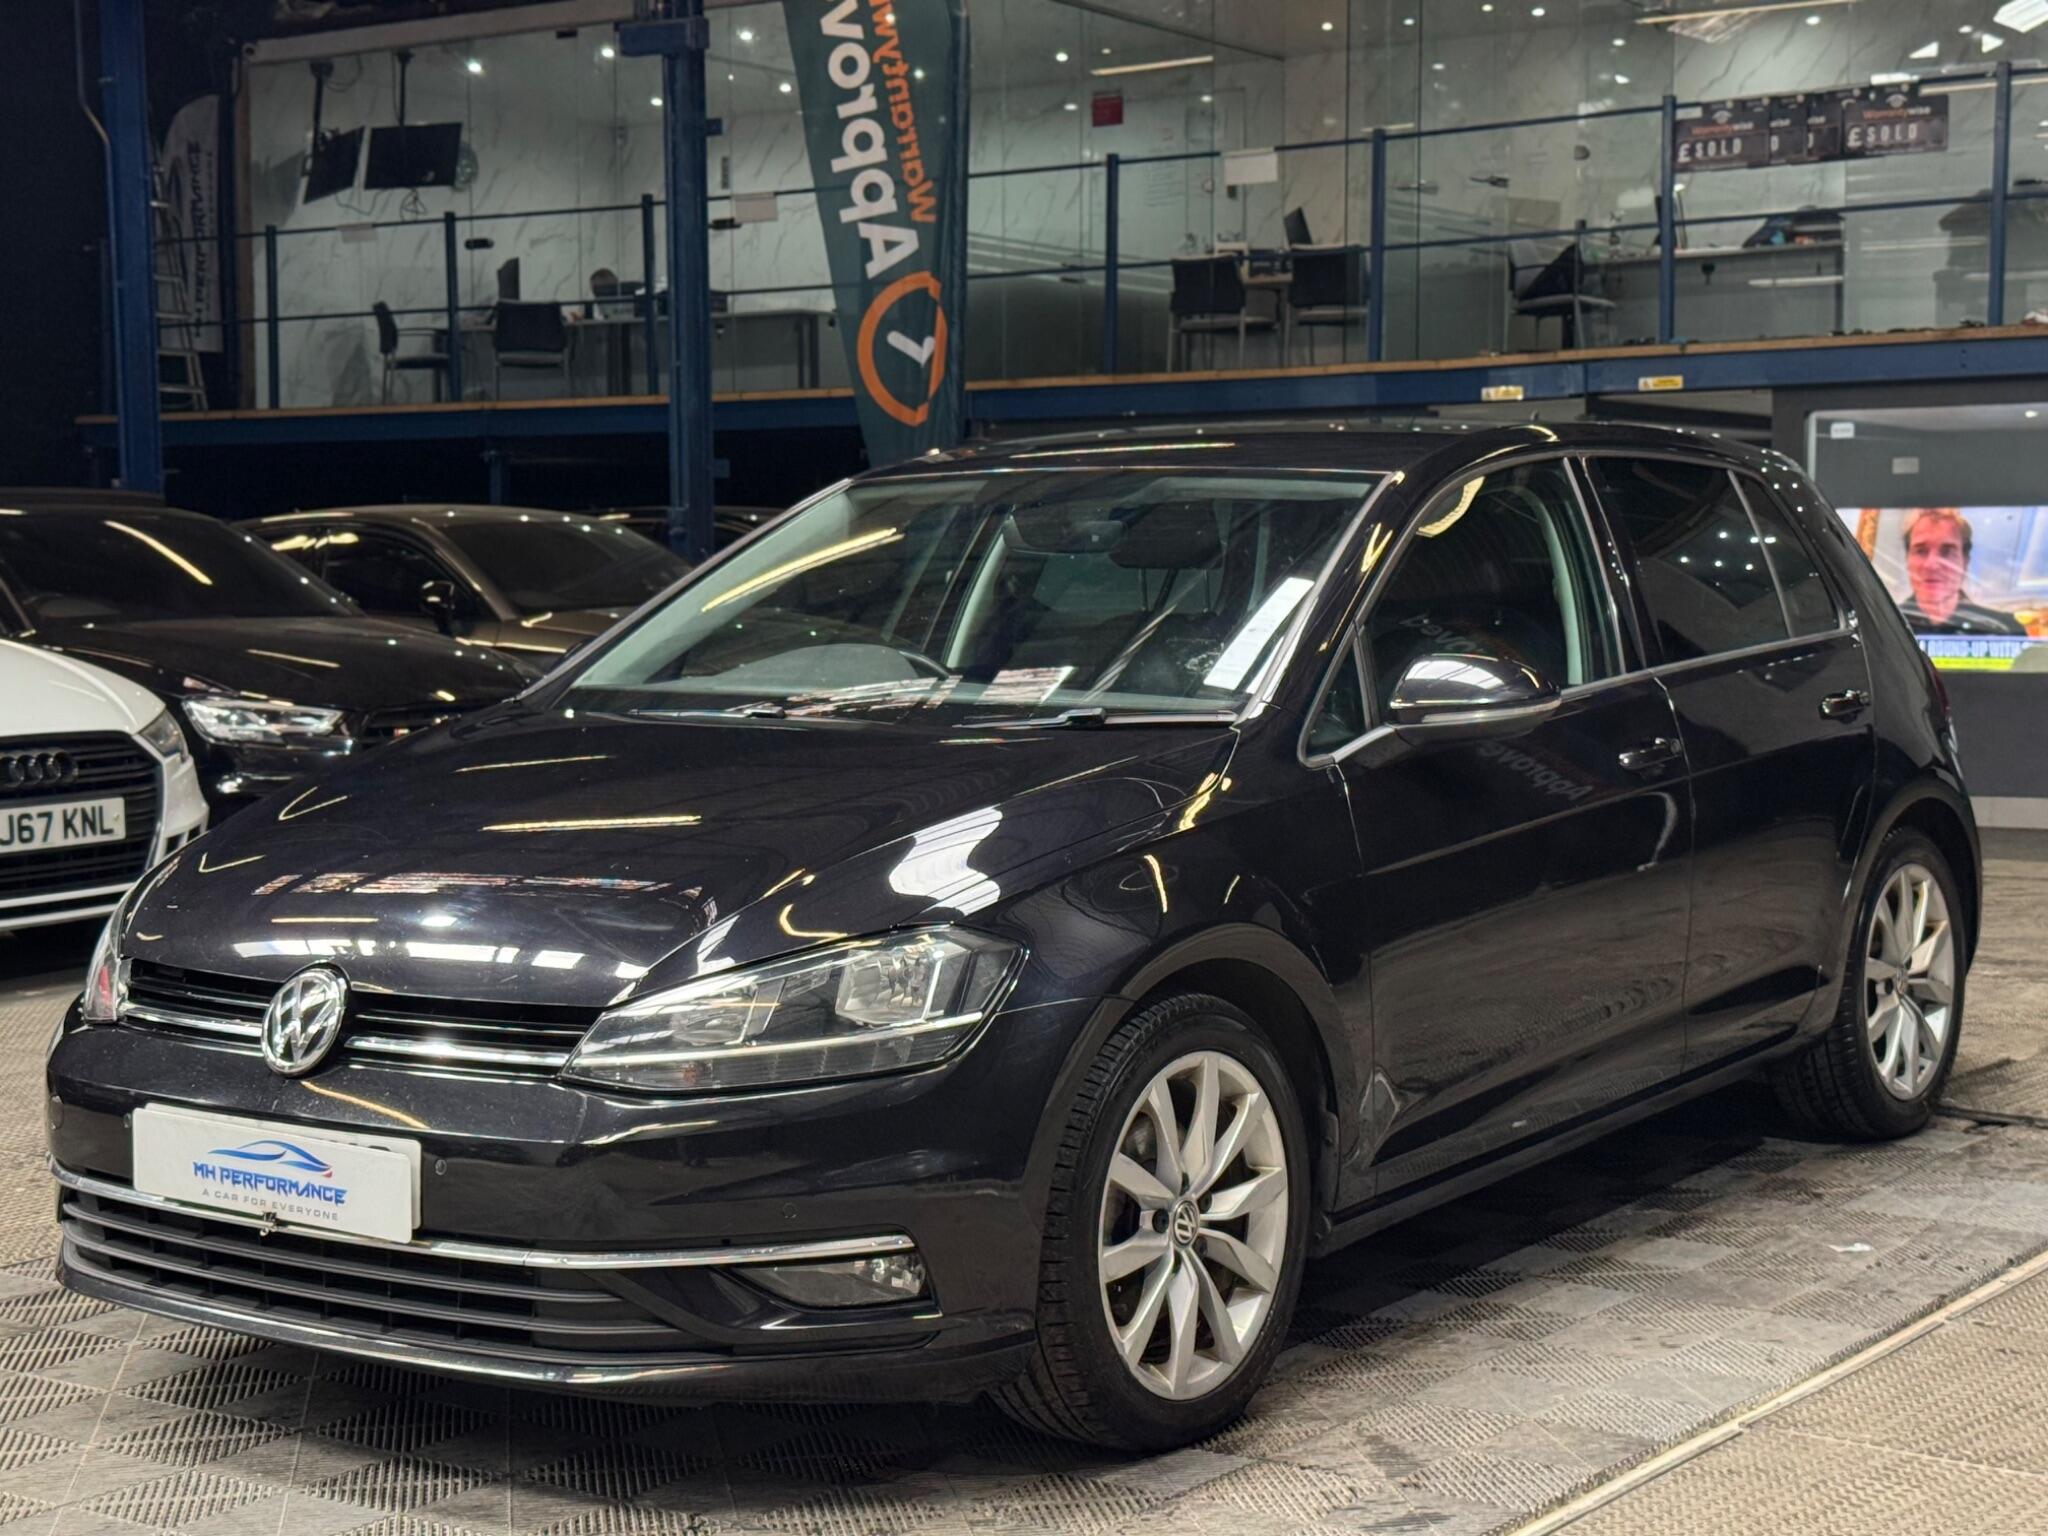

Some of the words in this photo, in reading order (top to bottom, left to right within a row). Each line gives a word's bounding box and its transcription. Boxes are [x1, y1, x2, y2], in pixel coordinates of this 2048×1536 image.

[62, 805, 114, 839] KNL
[193, 1161, 216, 1181] MH
[219, 1166, 348, 1206] PERFORMANCE
[202, 1188, 210, 1197] A
[214, 1191, 239, 1201] CAR
[243, 1196, 267, 1207] FOR
[272, 1201, 339, 1221] EVERYONE
